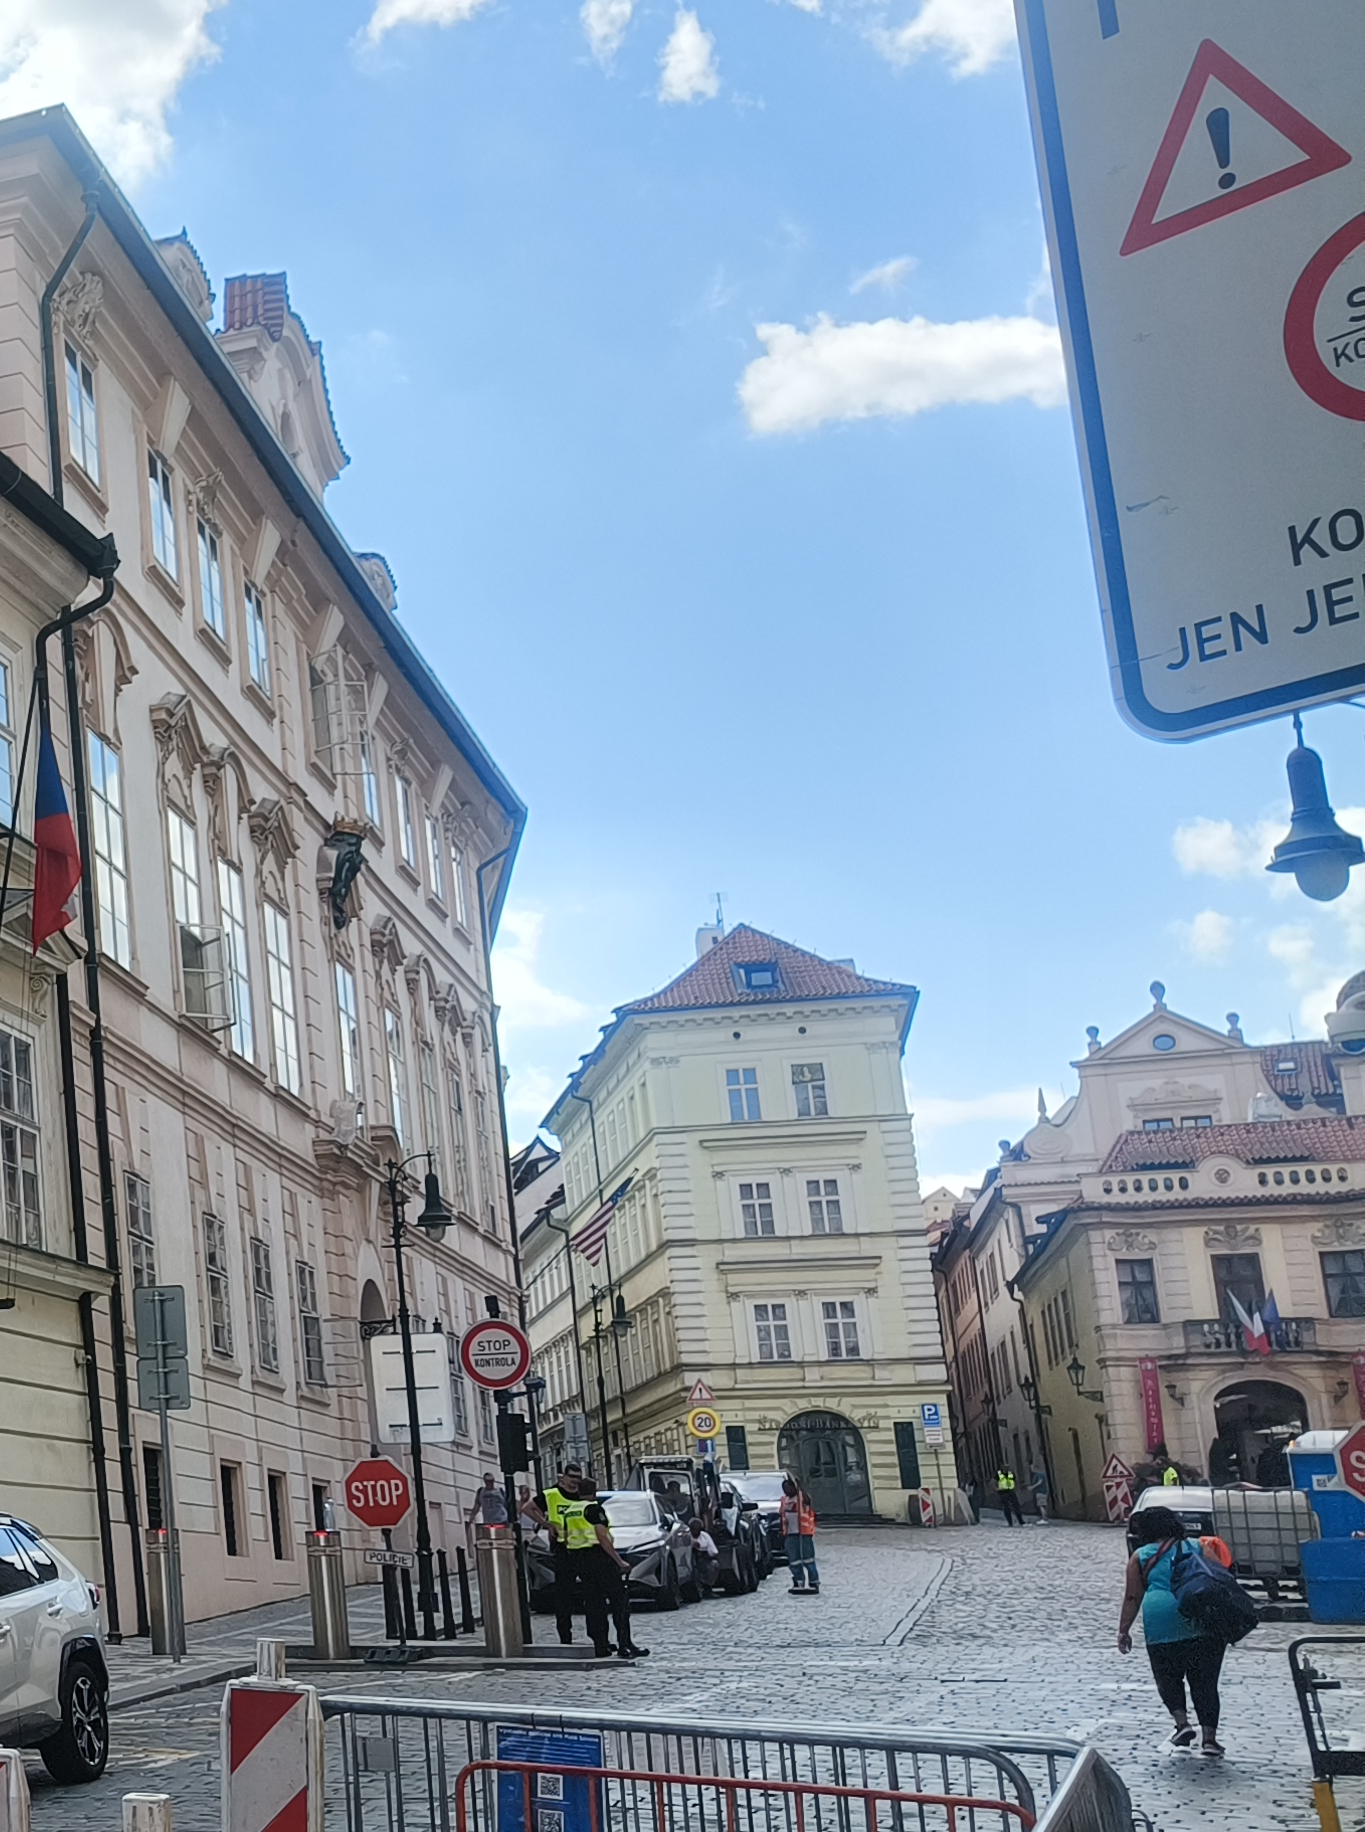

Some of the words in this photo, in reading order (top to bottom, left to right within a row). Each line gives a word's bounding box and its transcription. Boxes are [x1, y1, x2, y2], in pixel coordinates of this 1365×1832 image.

[1167, 604, 1269, 670] JEN
[1293, 573, 1365, 634] JE
[477, 1339, 511, 1351] STOP
[474, 1356, 517, 1368] KONTROLA
[697, 1416, 712, 1428] 20
[351, 1480, 403, 1507] STOP
[370, 1552, 408, 1565] POLICIE
